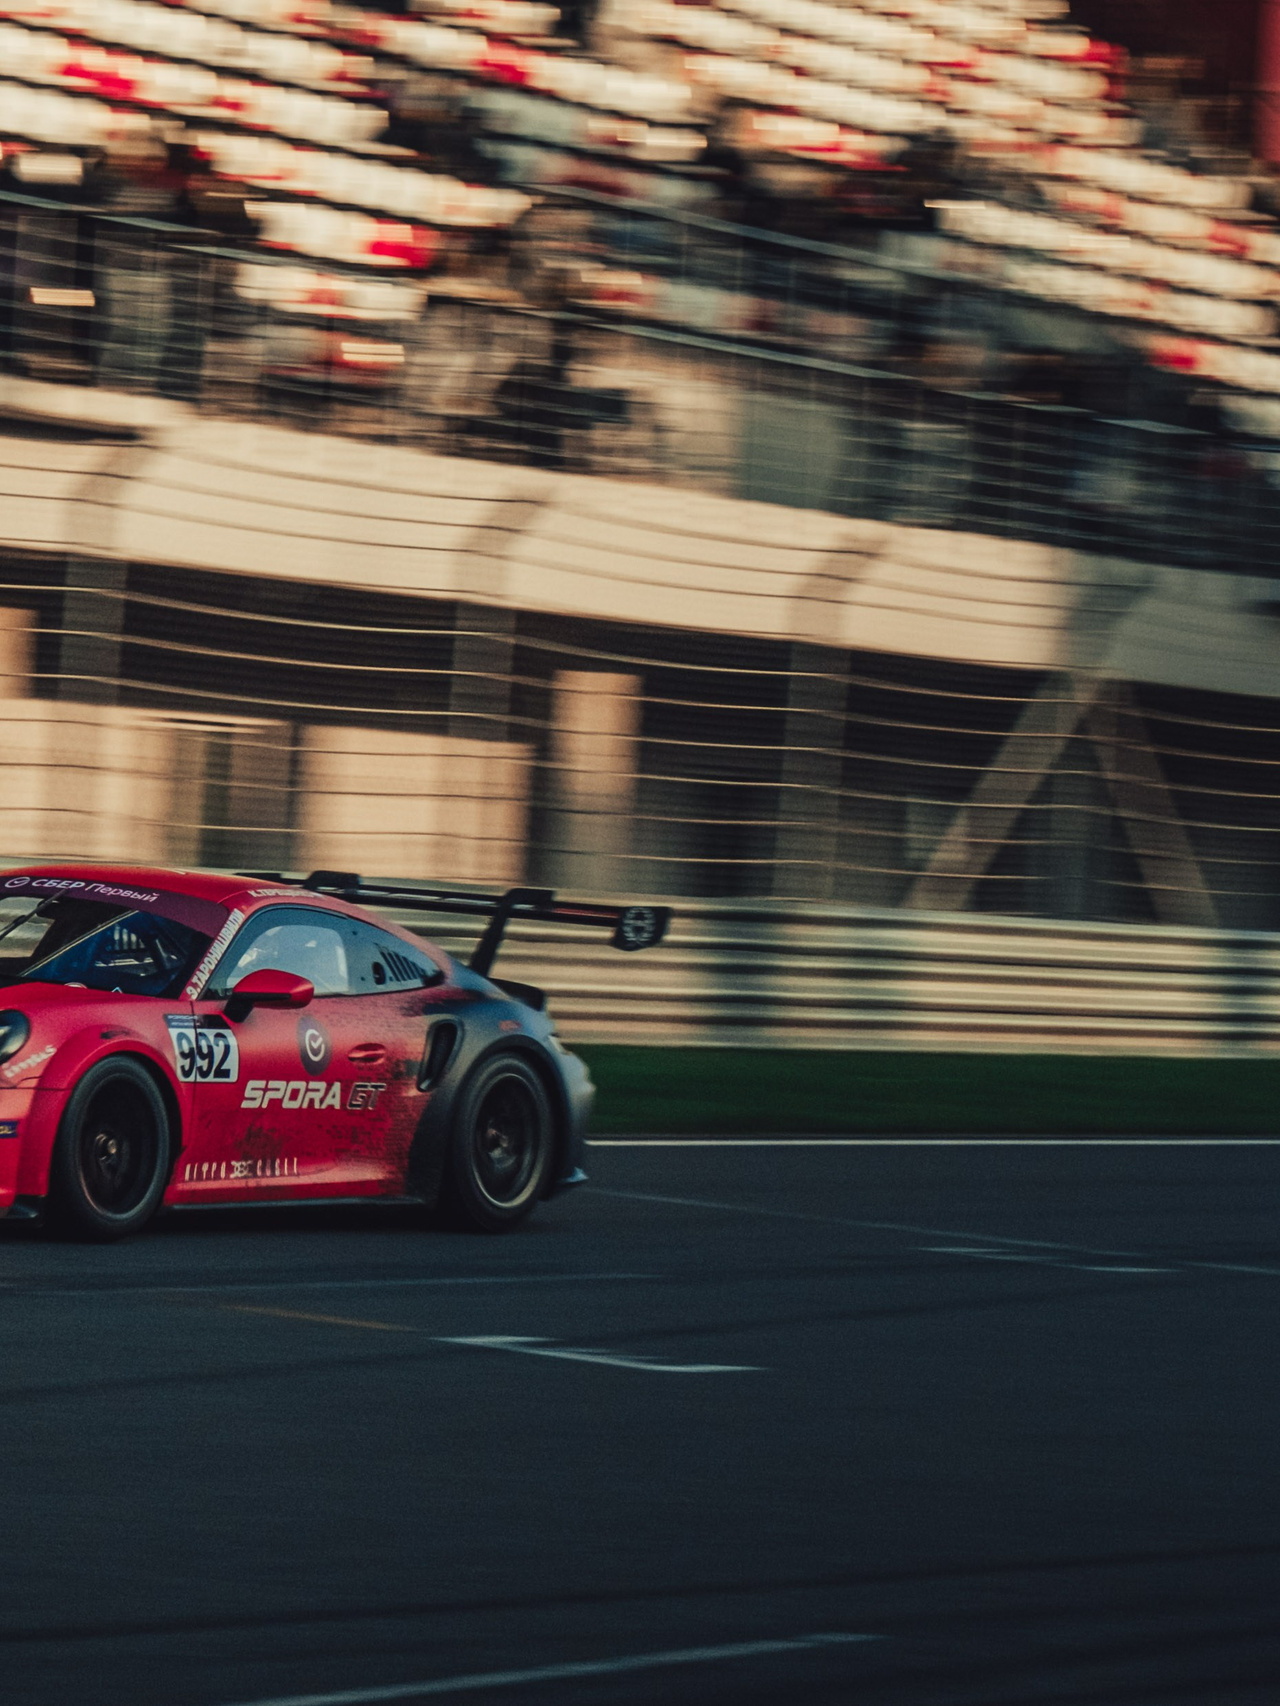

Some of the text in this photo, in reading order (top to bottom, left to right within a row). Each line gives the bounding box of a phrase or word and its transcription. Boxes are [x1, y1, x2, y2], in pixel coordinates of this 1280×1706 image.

[31, 878, 160, 903] СБЕР Первый
[176, 1031, 231, 1079] 992
[240, 1080, 387, 1110] SPORA GT
